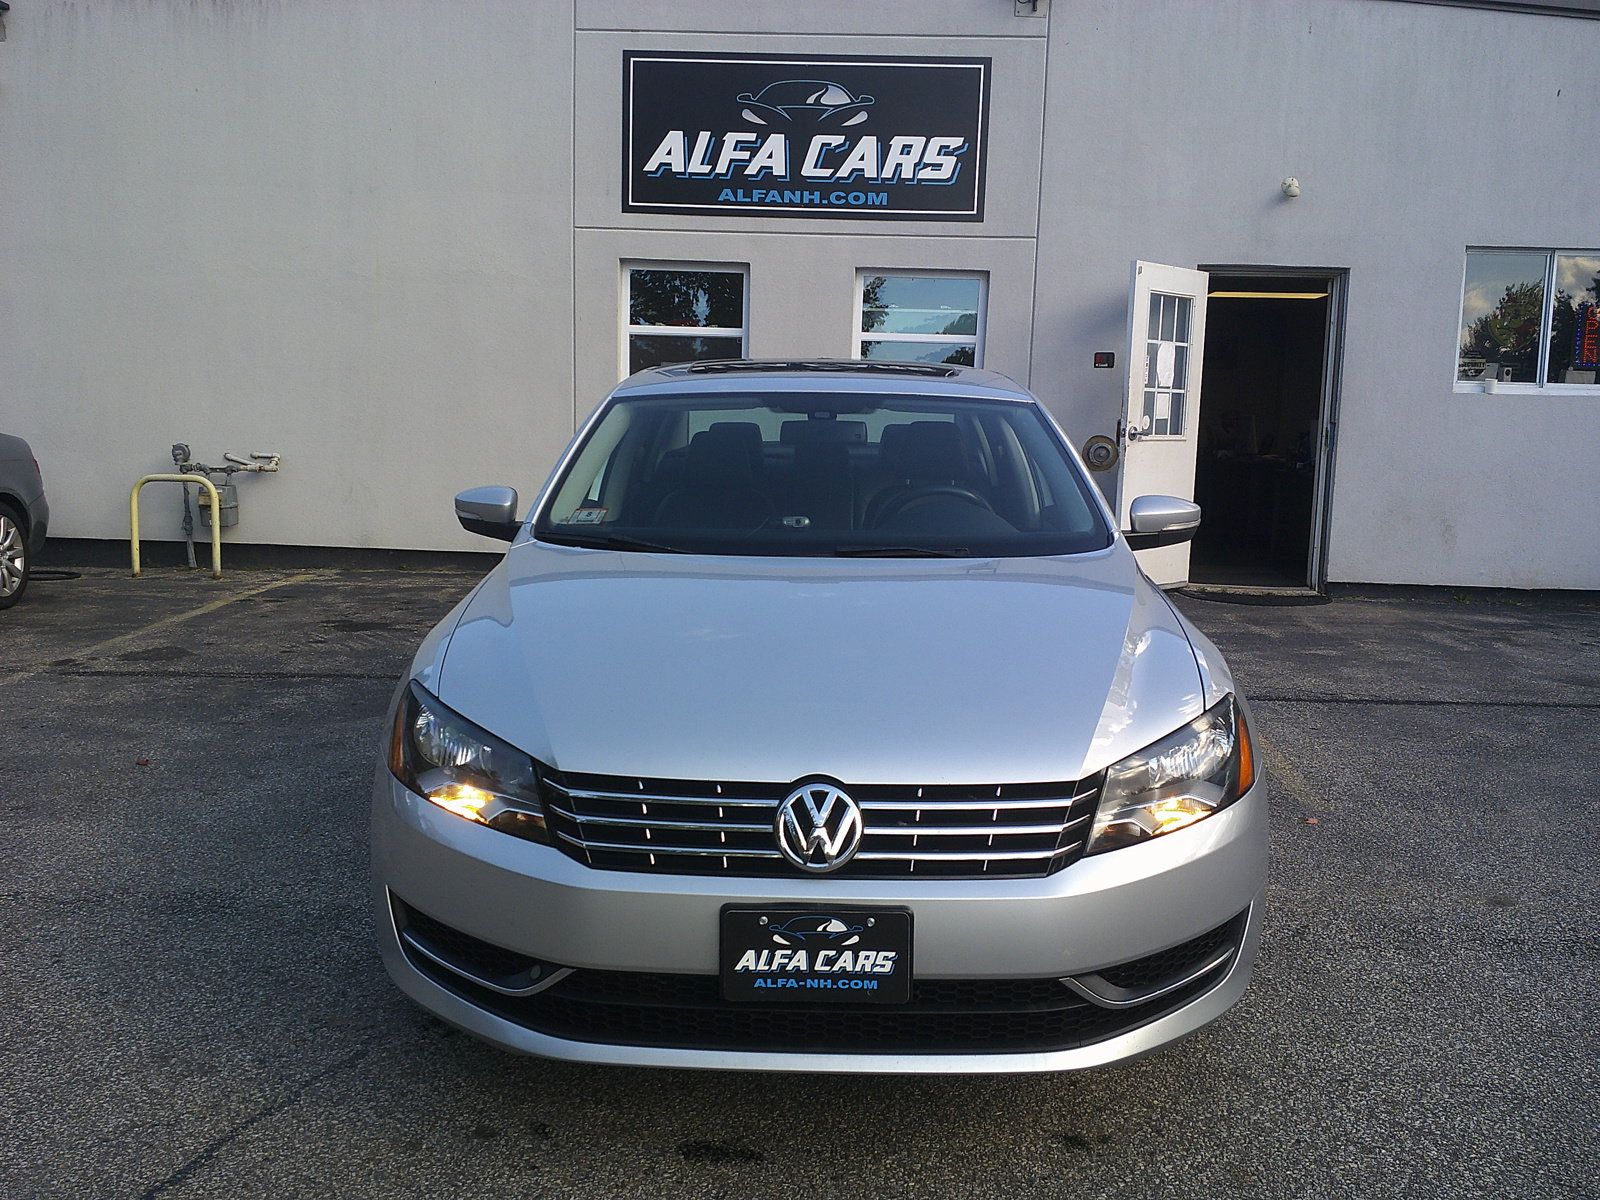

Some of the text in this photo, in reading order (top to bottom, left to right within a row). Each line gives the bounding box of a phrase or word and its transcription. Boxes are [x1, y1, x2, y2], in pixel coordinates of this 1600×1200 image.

[643, 130, 969, 186] ALFA CARS
[717, 188, 888, 206] ALFANH.COM
[735, 949, 898, 975] ALFA CARS
[753, 978, 878, 990] ALFA-NH.COM
